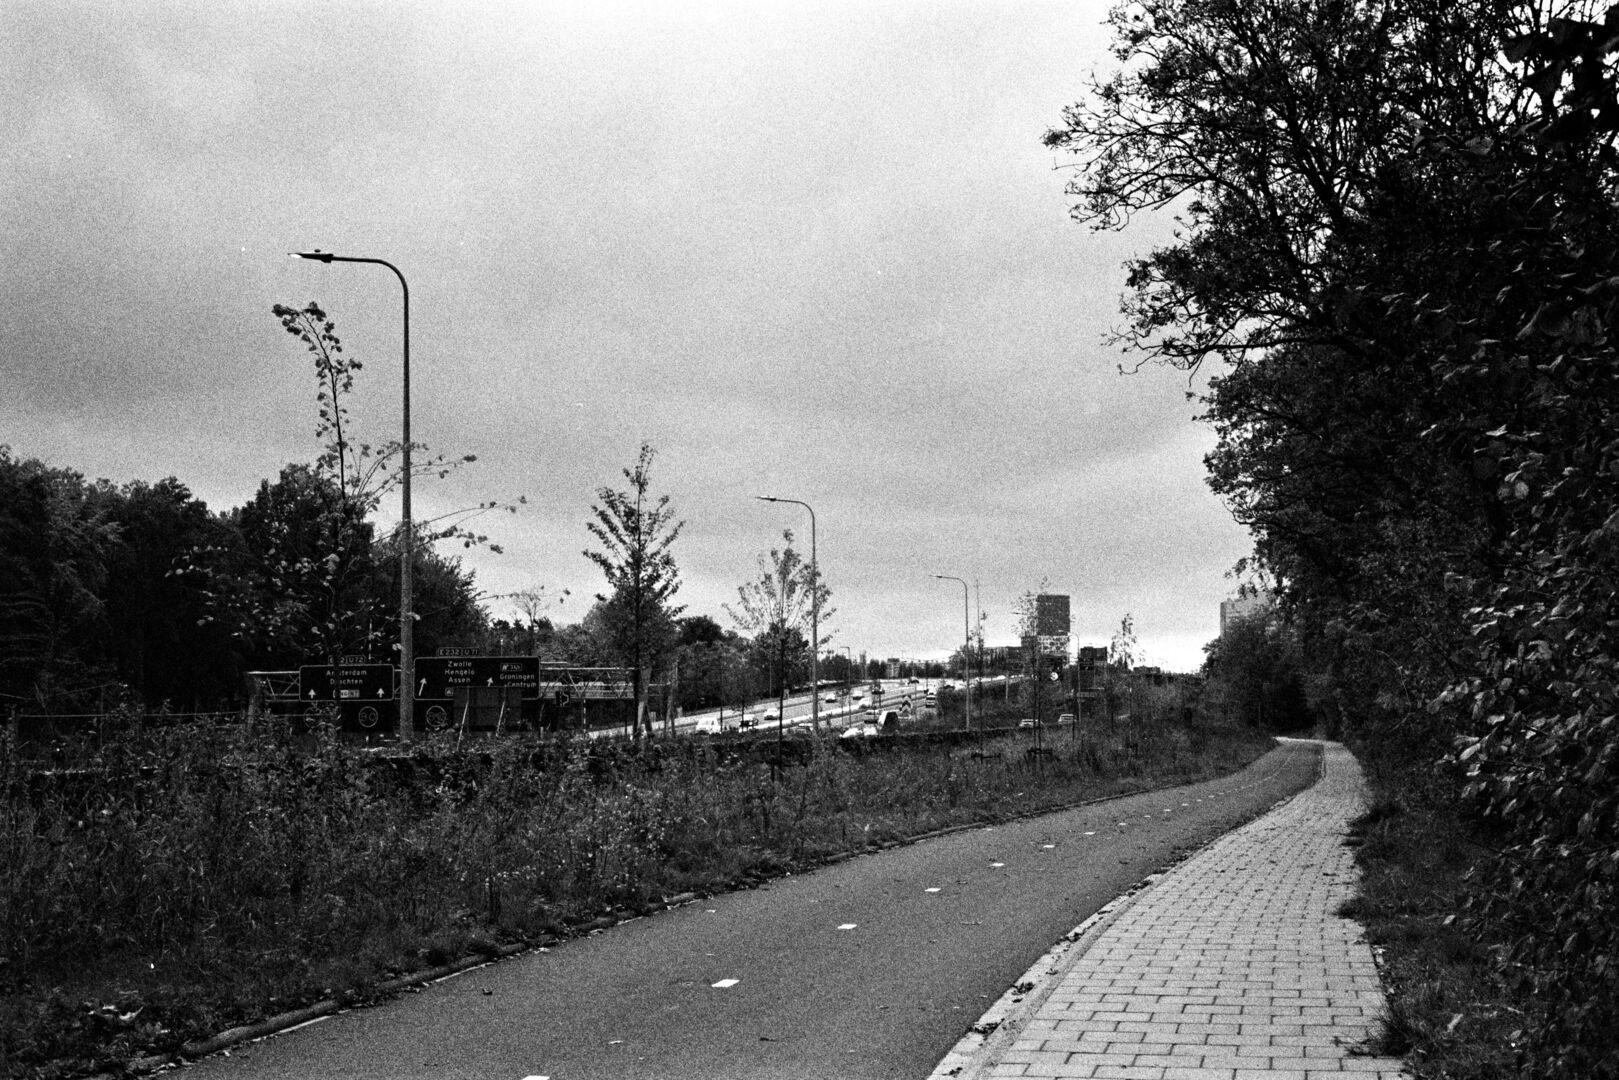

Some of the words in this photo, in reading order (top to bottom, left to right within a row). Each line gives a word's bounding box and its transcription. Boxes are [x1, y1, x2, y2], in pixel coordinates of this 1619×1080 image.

[447, 660, 473, 668] Zwolle
[444, 668, 475, 677] Hengelo
[447, 676, 471, 684] Assen
[499, 673, 536, 681] Groningen
